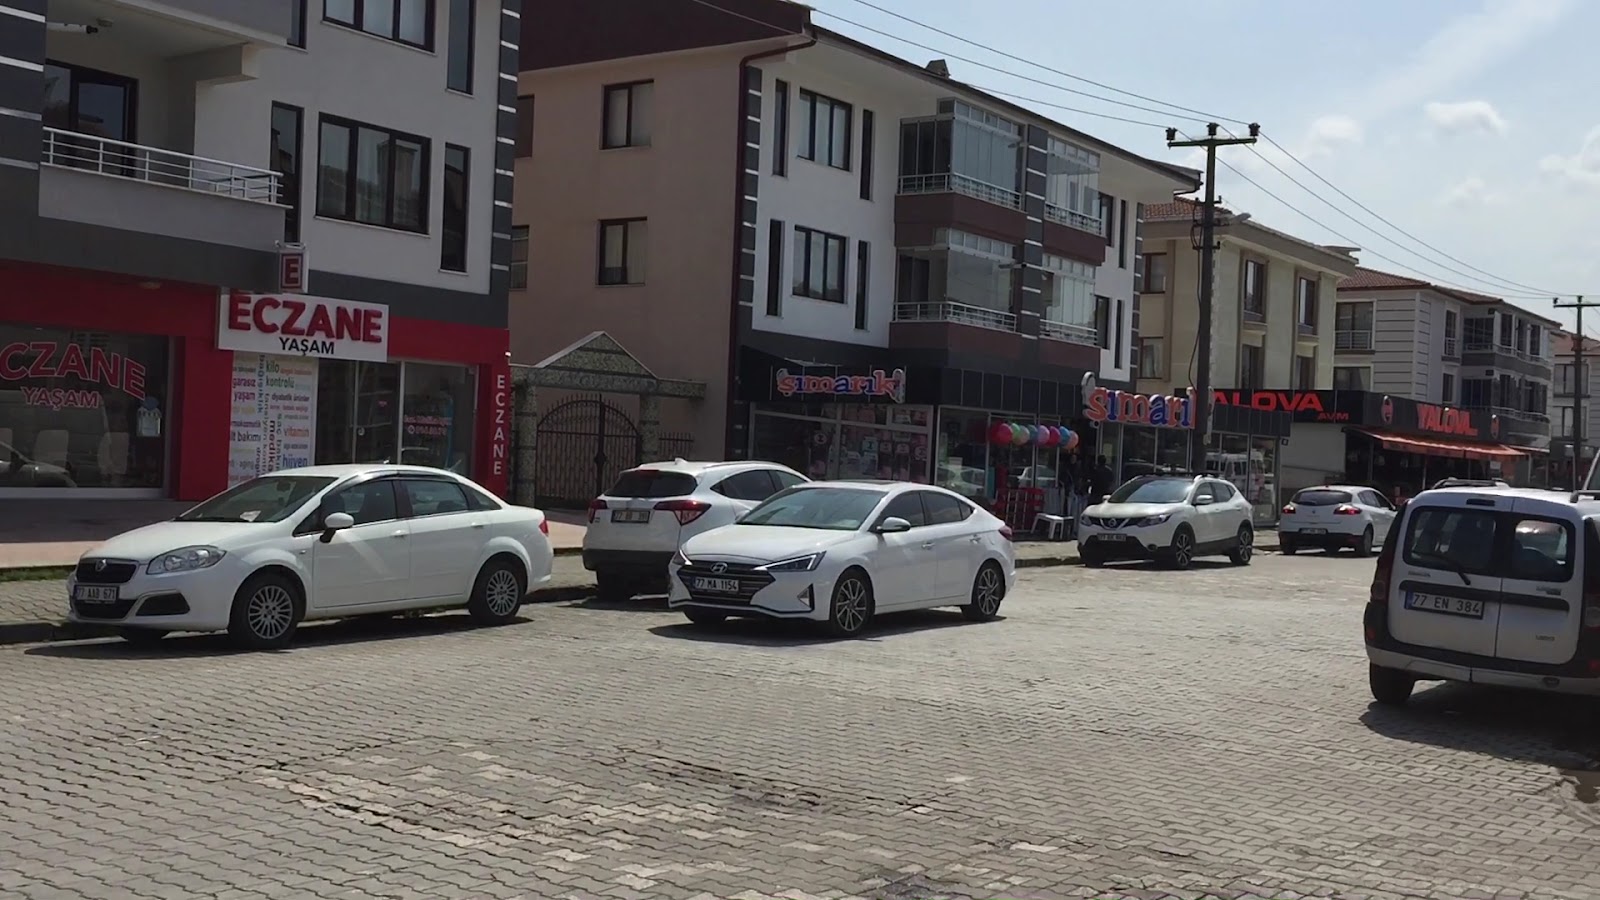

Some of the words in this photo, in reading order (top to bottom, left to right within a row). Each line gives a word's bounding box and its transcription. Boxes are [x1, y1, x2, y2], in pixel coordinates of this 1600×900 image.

[285, 258, 300, 285] E
[228, 288, 383, 344] ECZANE
[279, 337, 335, 356] YAŞAM
[266, 360, 280, 374] kilo
[266, 376, 295, 389] kontrolü
[20, 386, 100, 411] YAŞAM
[234, 391, 256, 402] yaşam
[493, 374, 506, 475] ECZANE
[1317, 412, 1349, 421] AVM
[697, 579, 705, 588] 77
[1413, 594, 1428, 606] 77
[1434, 597, 1449, 610] EN
[1456, 600, 1480, 613] 384
